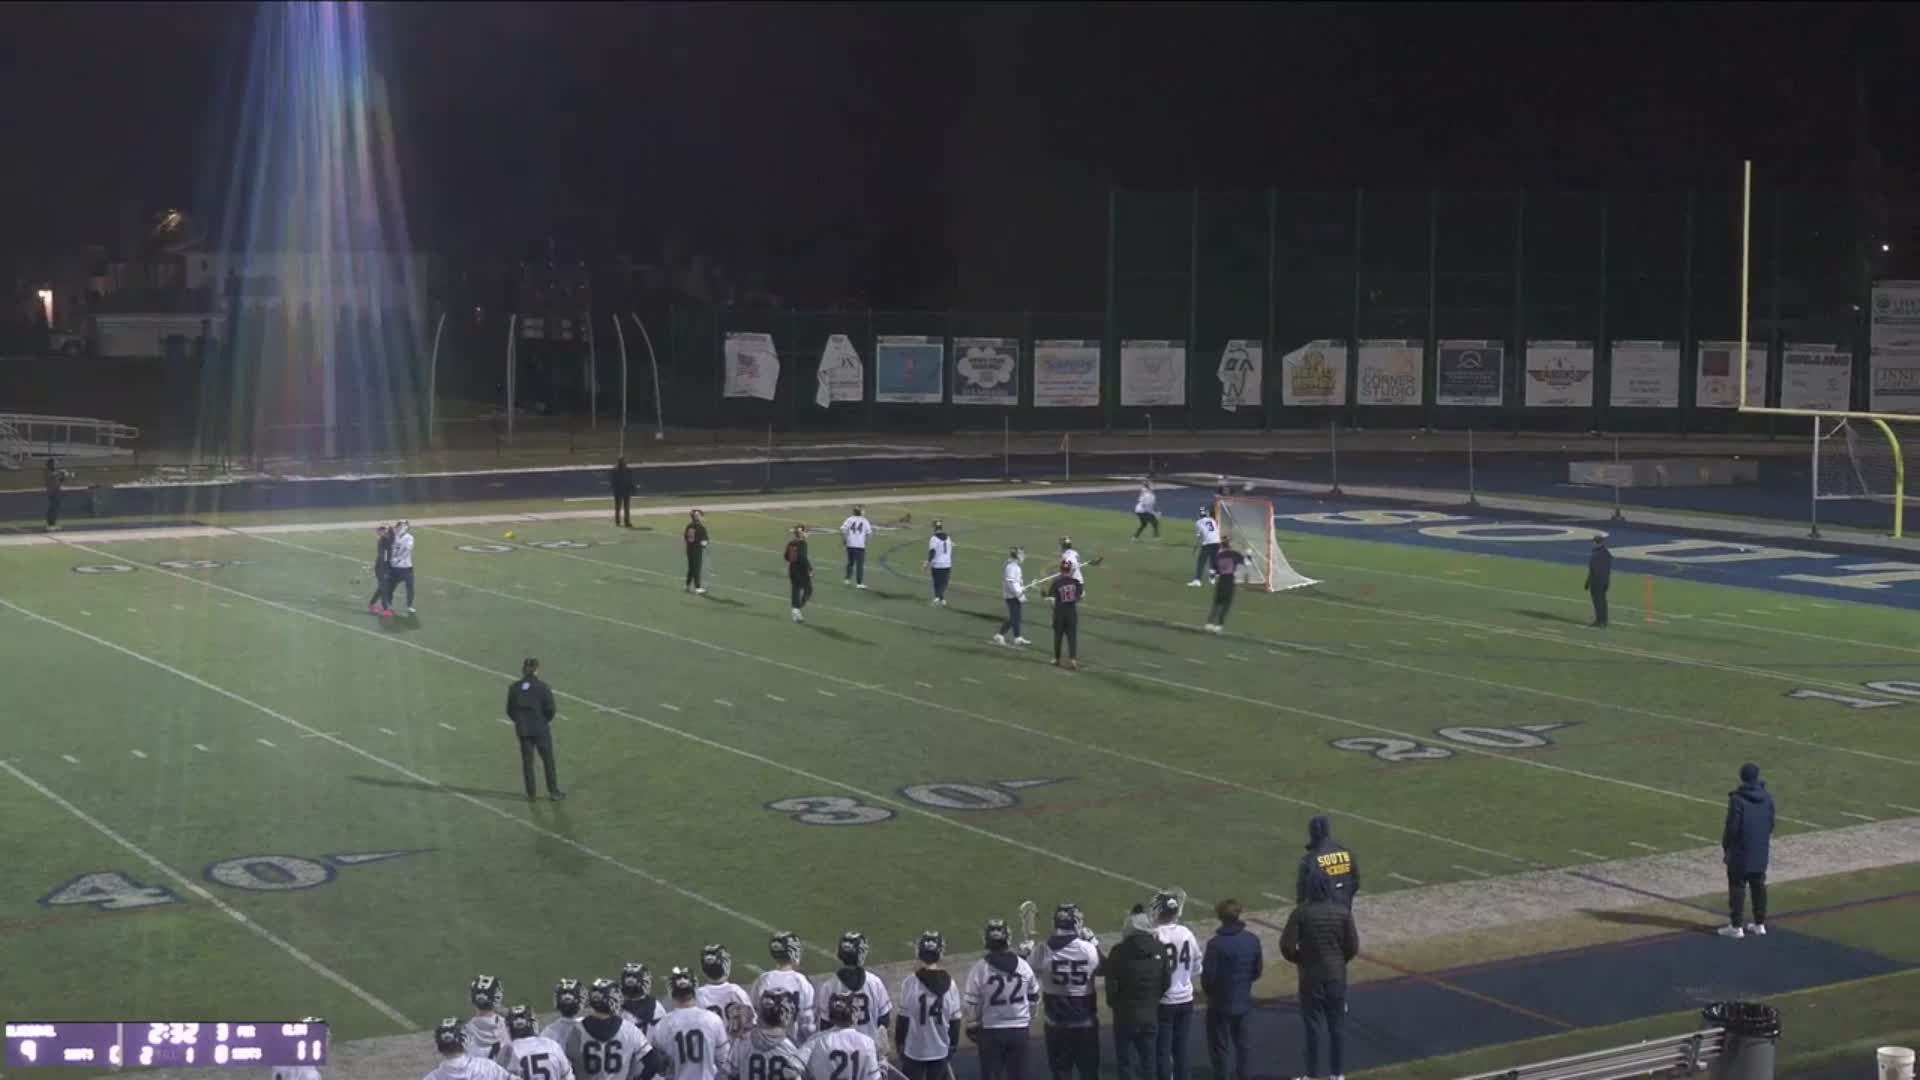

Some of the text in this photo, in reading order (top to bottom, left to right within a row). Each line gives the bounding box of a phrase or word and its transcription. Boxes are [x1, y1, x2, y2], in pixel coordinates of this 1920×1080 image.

[1361, 375, 1415, 385] CORNER
[1361, 385, 1417, 397] STUDIO
[849, 521, 864, 535] 44
[1329, 726, 1555, 761] 20
[764, 781, 1018, 825] 30
[1317, 851, 1351, 868] SOUTH
[38, 855, 338, 910] 40
[1052, 960, 1089, 986] 55
[987, 973, 1024, 1006] 22
[919, 993, 944, 1026] 14
[583, 1040, 622, 1075] 66
[674, 1028, 705, 1065] 10
[519, 1052, 550, 1080] 15
[828, 1050, 861, 1080] 21
